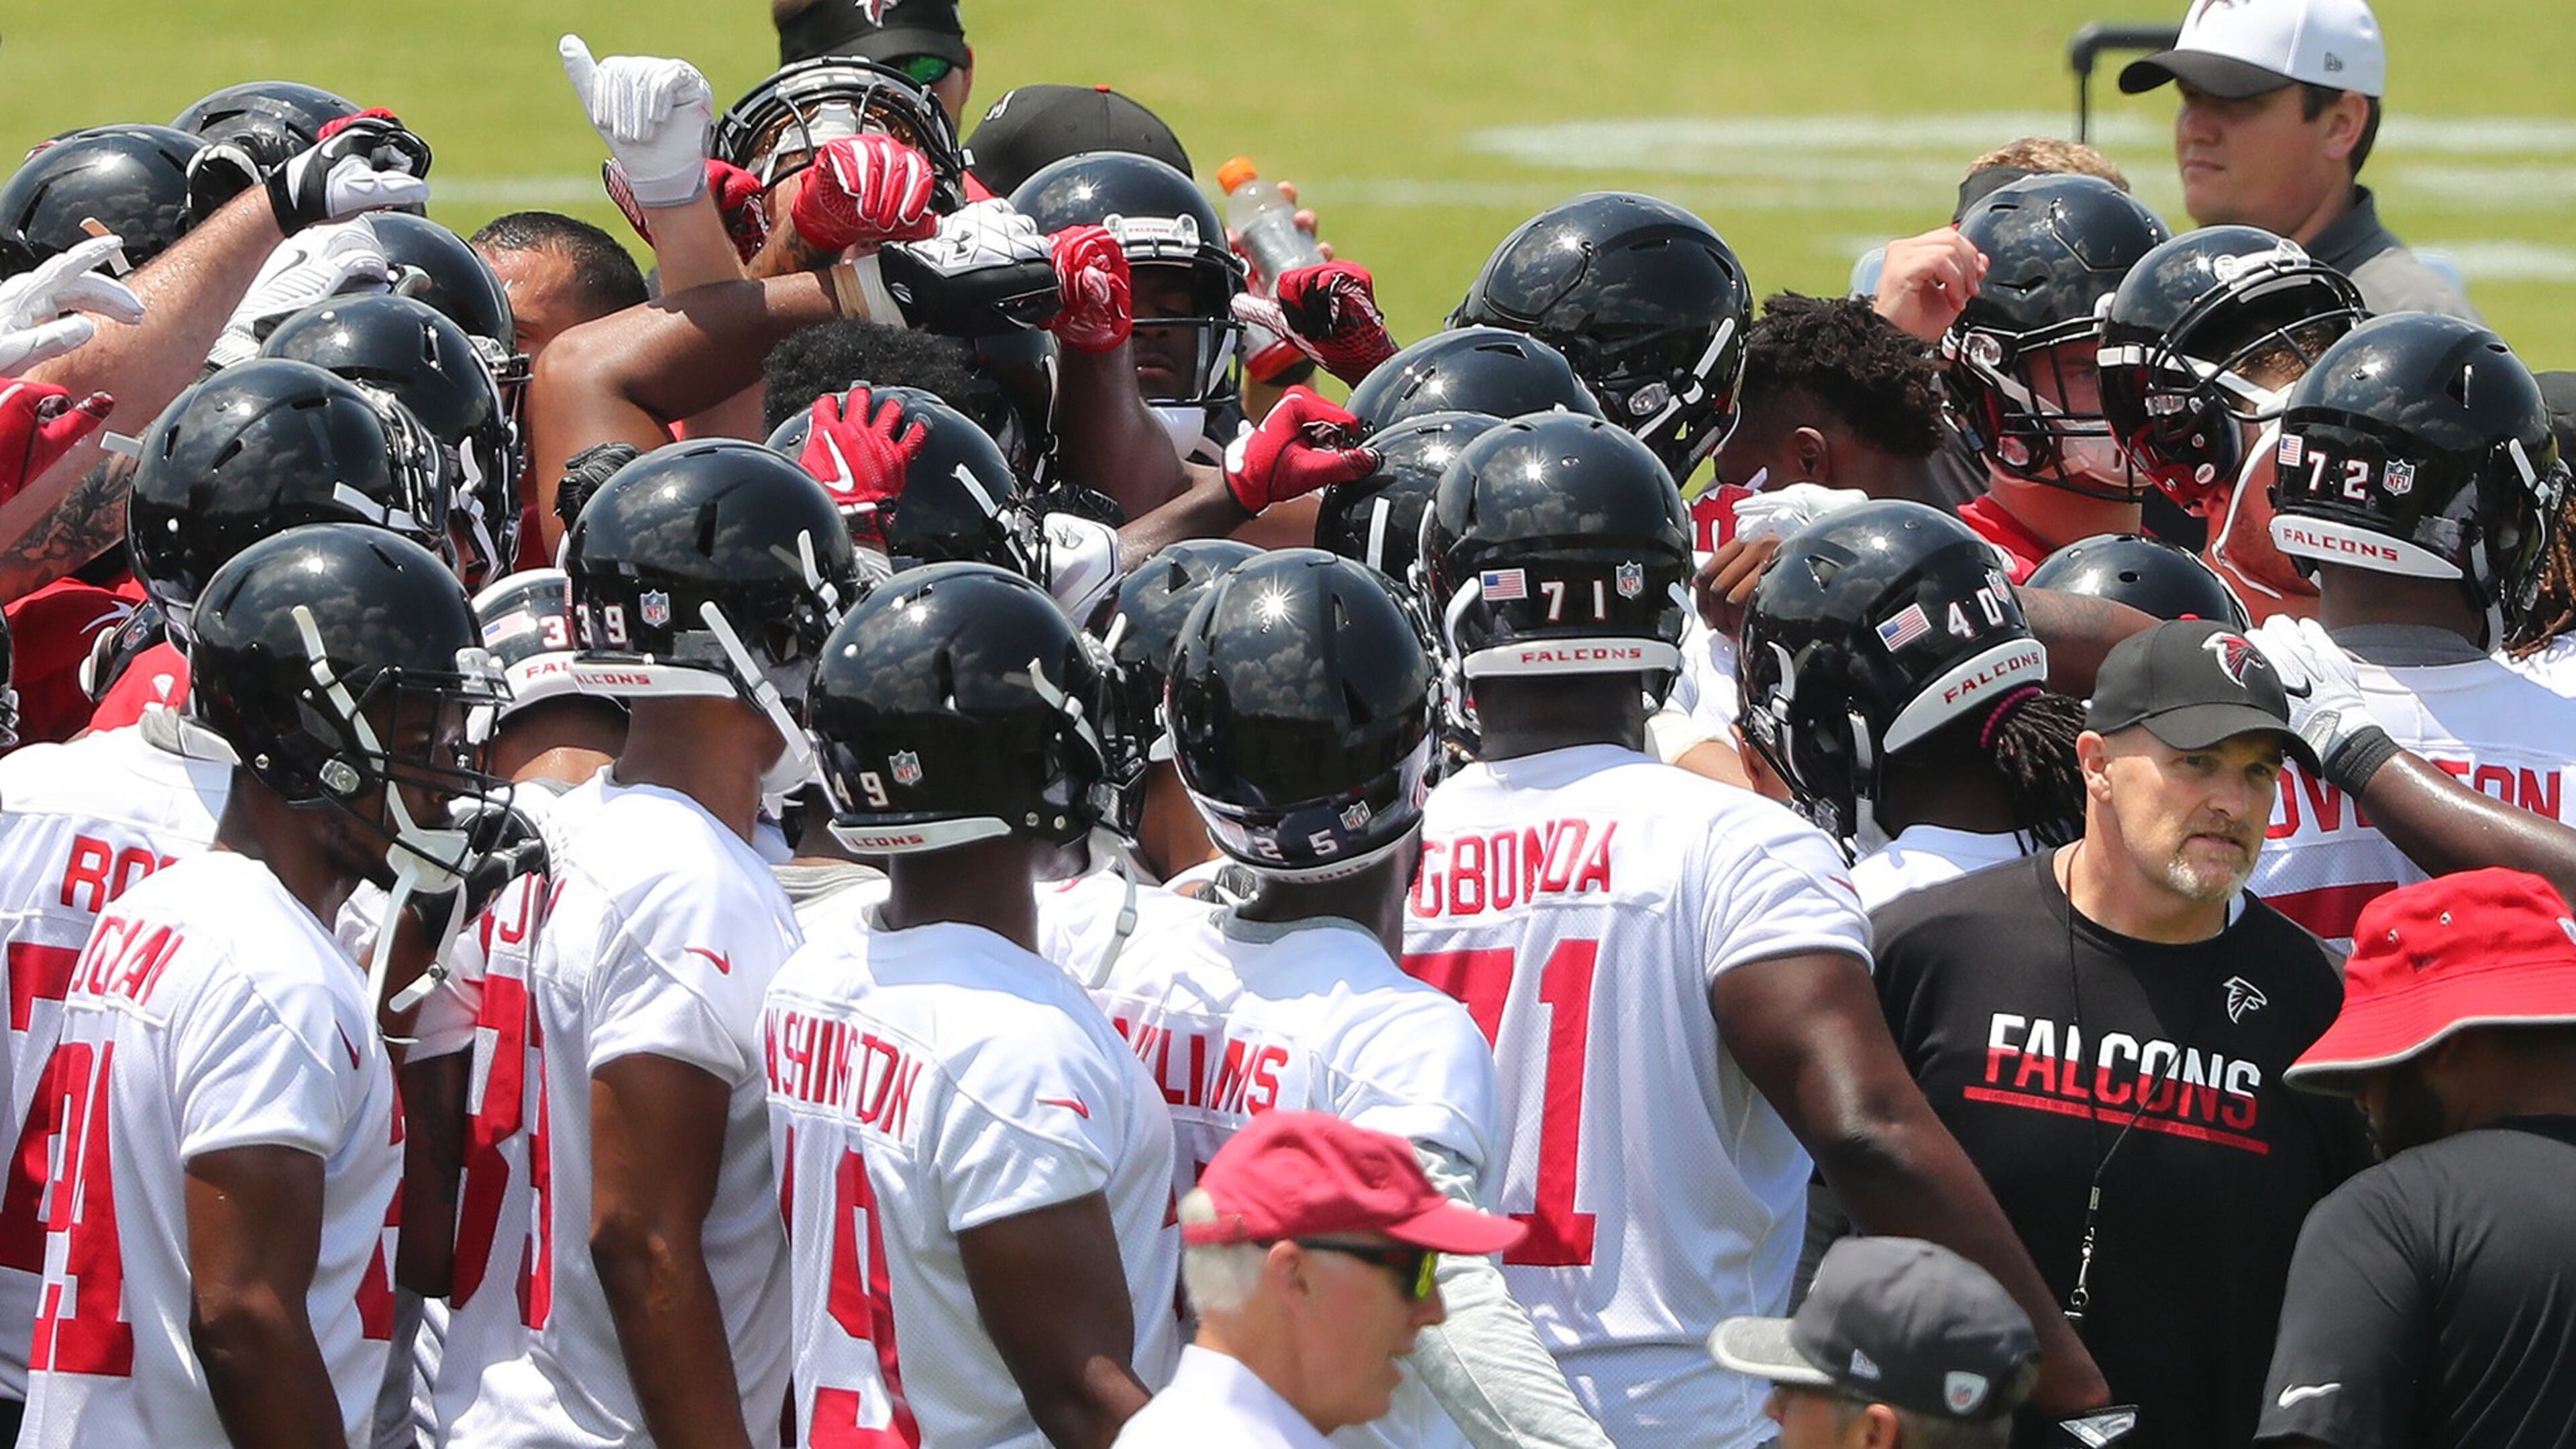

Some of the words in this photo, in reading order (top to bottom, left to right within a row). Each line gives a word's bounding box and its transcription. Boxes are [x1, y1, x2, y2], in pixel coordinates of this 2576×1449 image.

[2307, 450, 2370, 501] 72
[2387, 474, 2408, 489] NFL
[2283, 527, 2399, 562] FALCONS
[1540, 580, 1606, 621] 71
[1619, 576, 1641, 590] NFL
[1521, 647, 1642, 663] FALCONS
[1943, 651, 2041, 705] FALCONS
[1983, 1012, 2261, 1130] FALCONS
